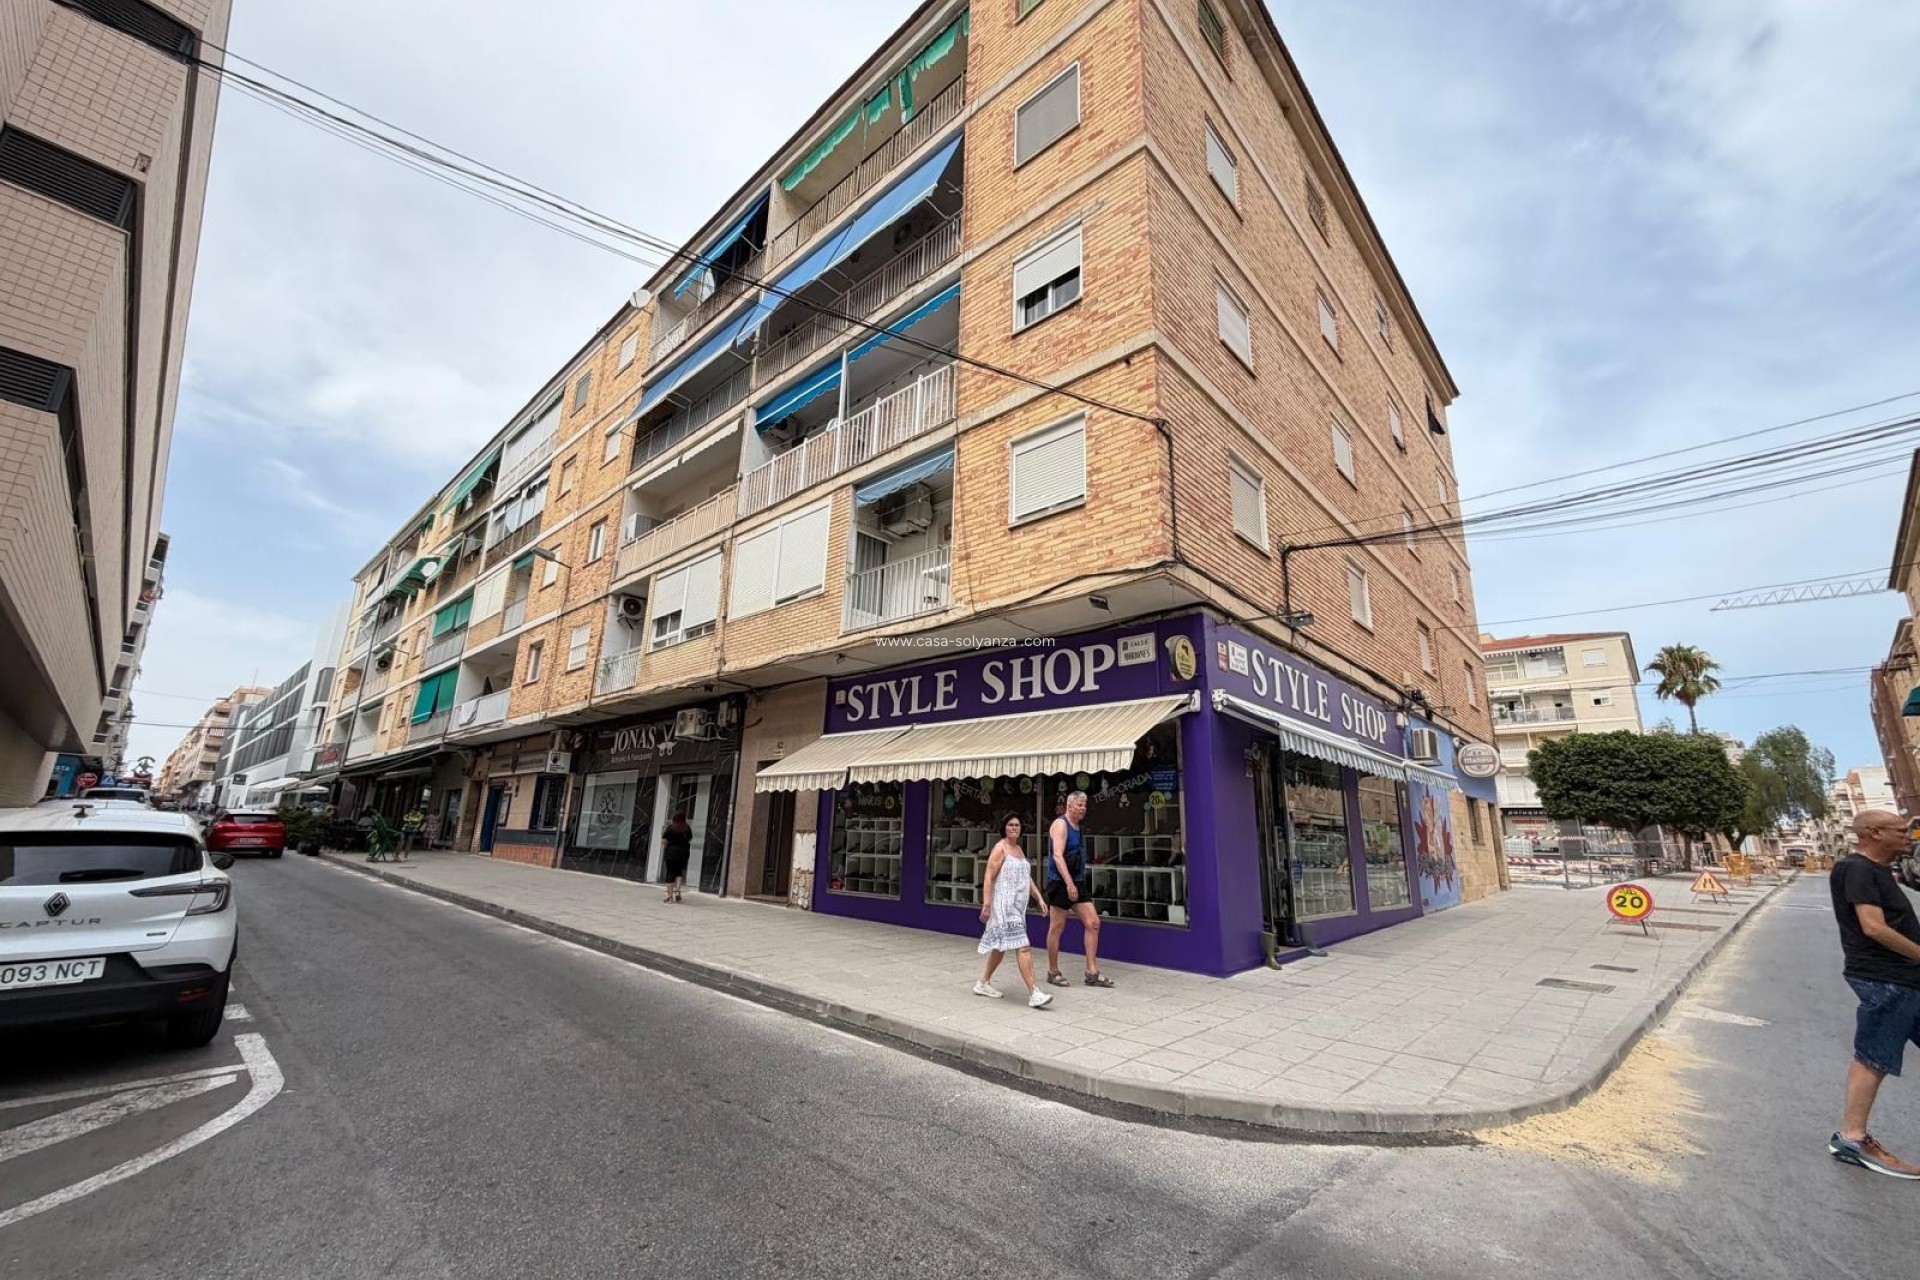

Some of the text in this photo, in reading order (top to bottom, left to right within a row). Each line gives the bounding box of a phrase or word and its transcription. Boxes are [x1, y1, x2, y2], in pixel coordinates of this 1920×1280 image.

[846, 643, 1115, 722] STYLE SHOP
[1252, 648, 1331, 723] STYLE
[1341, 692, 1387, 745] SHOP
[611, 725, 657, 754] JONAS
[1092, 771, 1152, 804] TEMPORADA
[1615, 895, 1643, 909] 20
[0, 917, 101, 929] CAPTUR
[0, 960, 99, 984] 093 NCT
